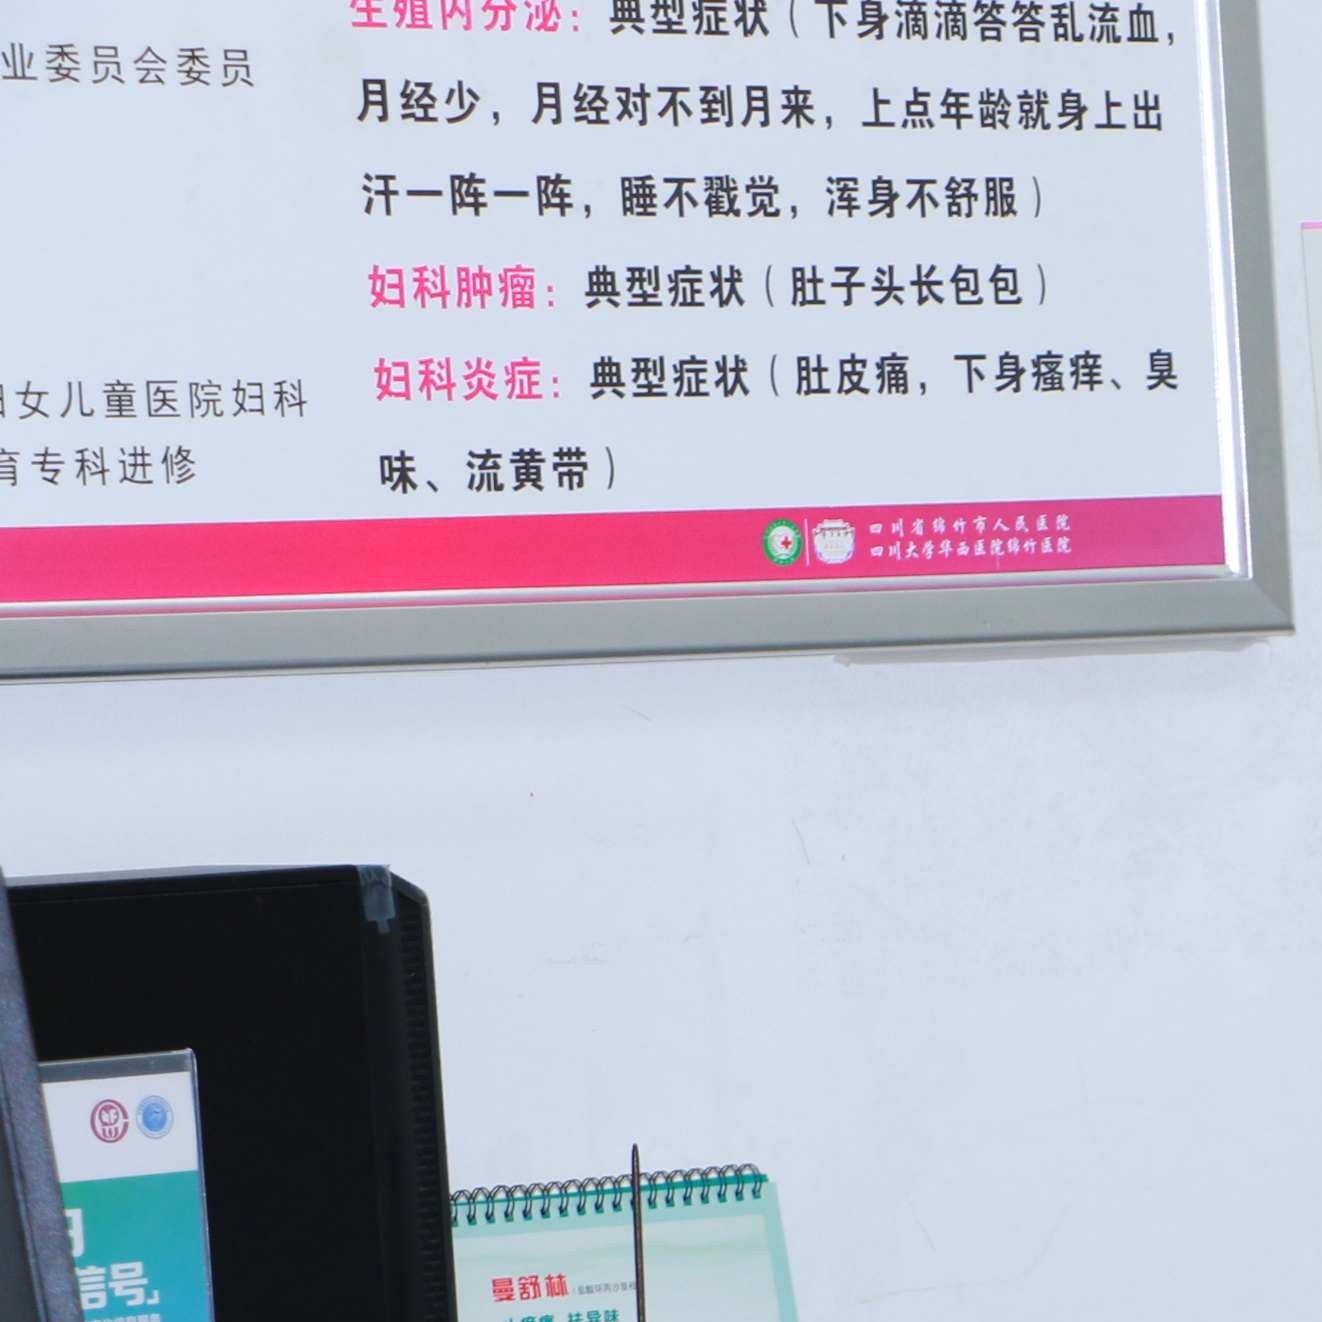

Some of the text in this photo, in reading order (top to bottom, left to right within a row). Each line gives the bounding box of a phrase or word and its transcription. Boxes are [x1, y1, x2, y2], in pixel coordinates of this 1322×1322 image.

[0, 42, 255, 88] 业委员会委员
[0, 379, 308, 419] 女儿童医院妇科
[869, 514, 1071, 537] 四川省绵竹市人民医院
[870, 536, 1072, 560] 四川大学华西医院绵竹医院
[491, 1273, 569, 1302] 曼舒林
